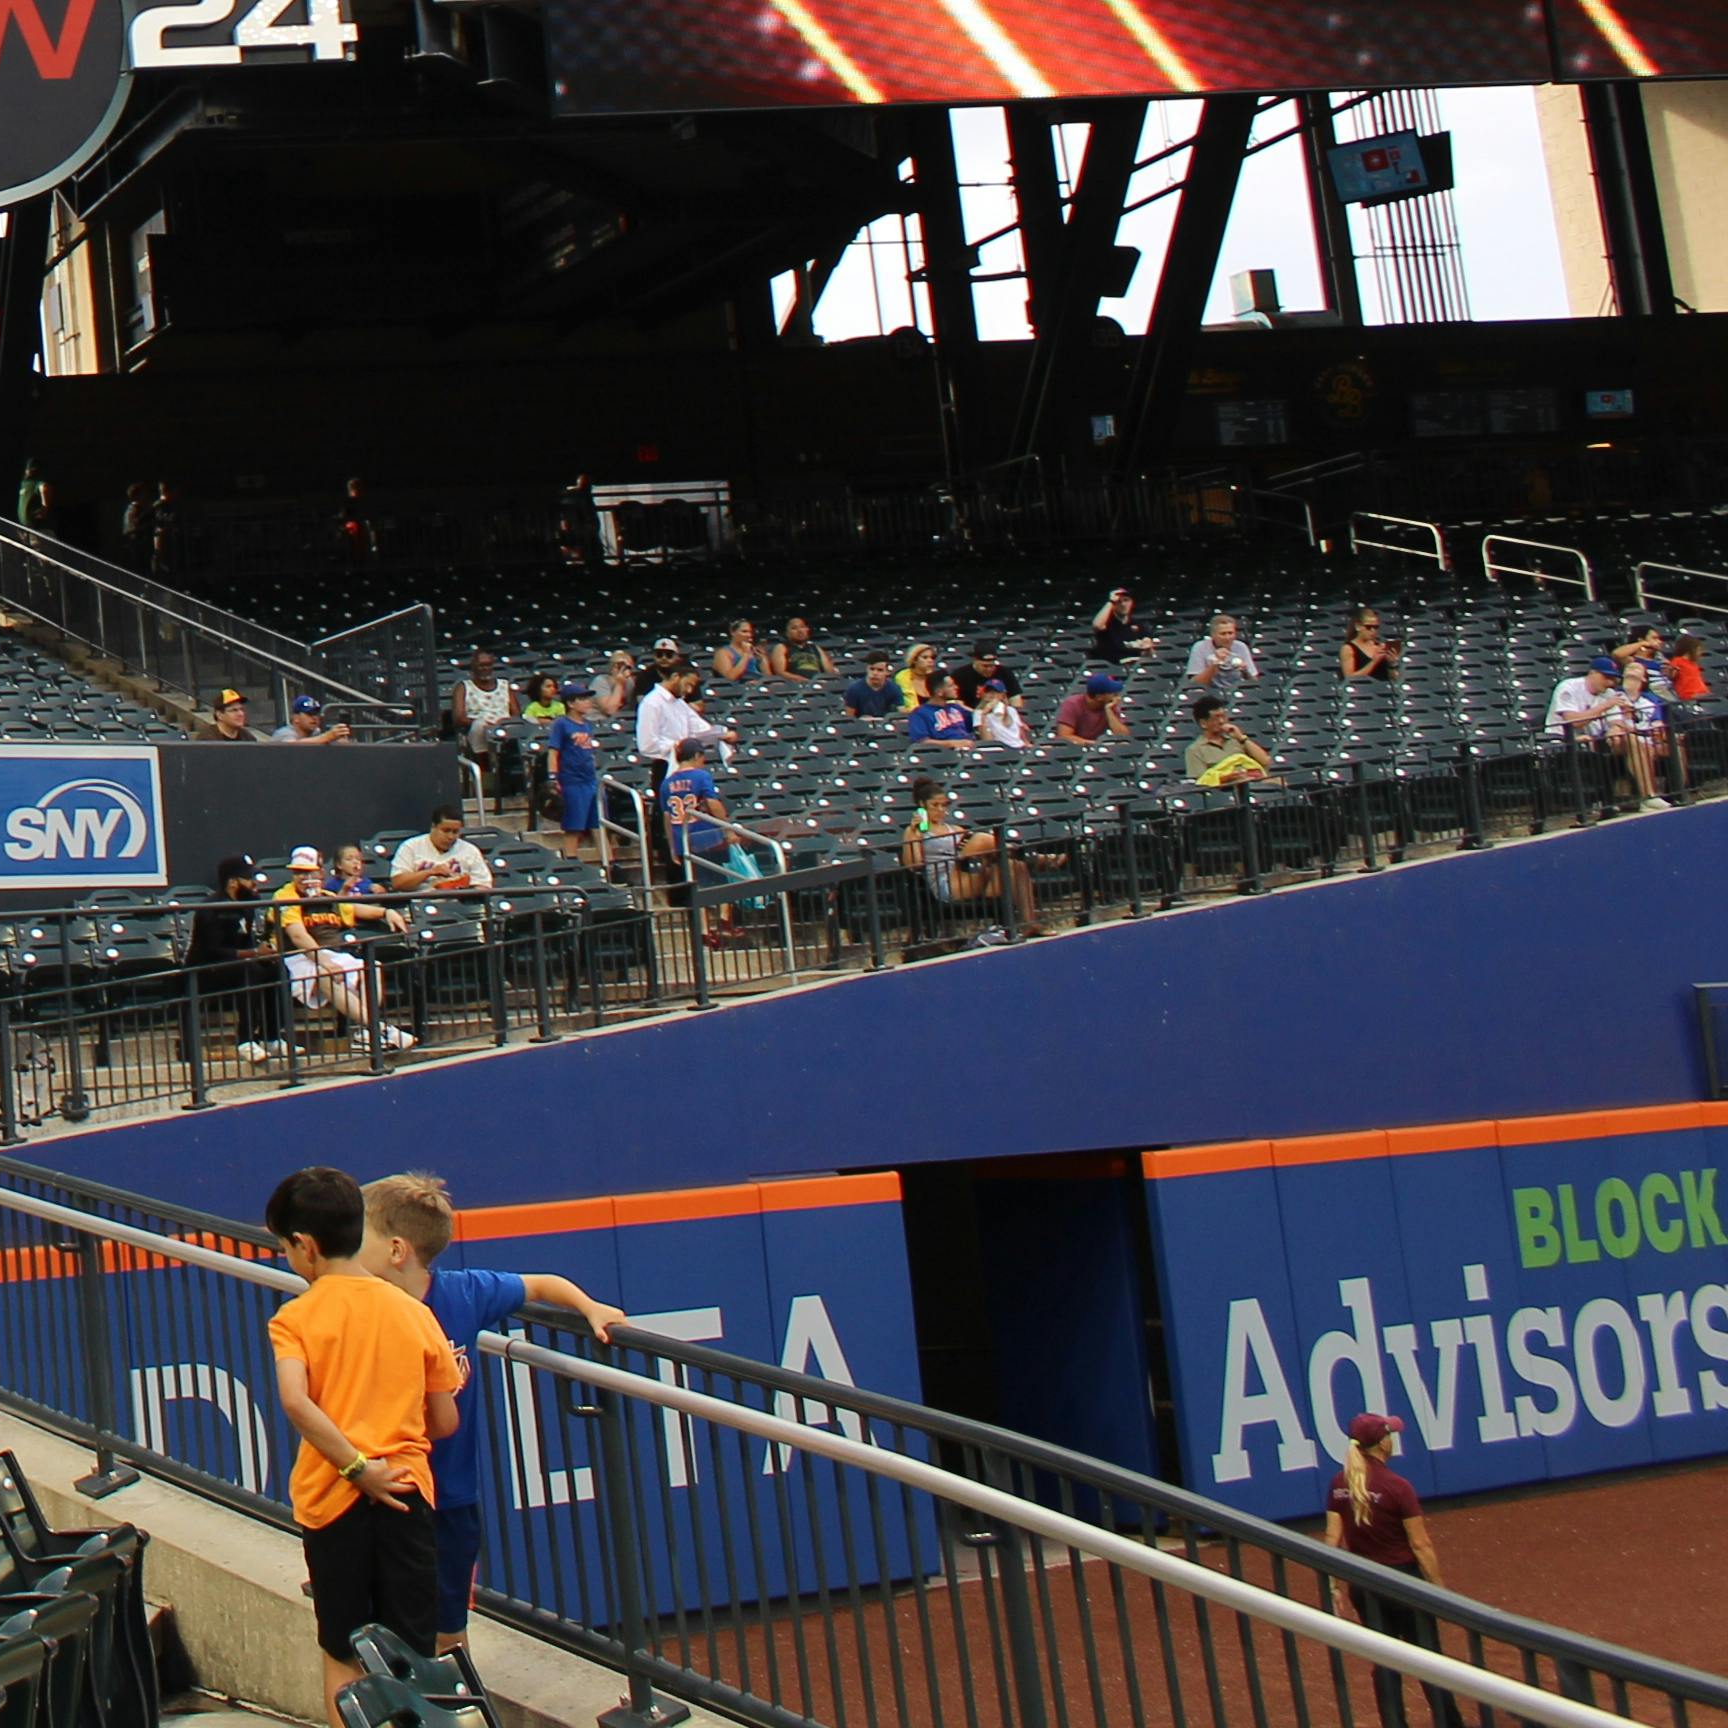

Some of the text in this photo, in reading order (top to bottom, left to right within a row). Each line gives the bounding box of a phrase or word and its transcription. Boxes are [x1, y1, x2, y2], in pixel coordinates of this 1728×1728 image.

[4, 805, 126, 860] SNY
[1512, 1166, 1728, 1269] BLOCK
[130, 1294, 880, 1512] DLTA
